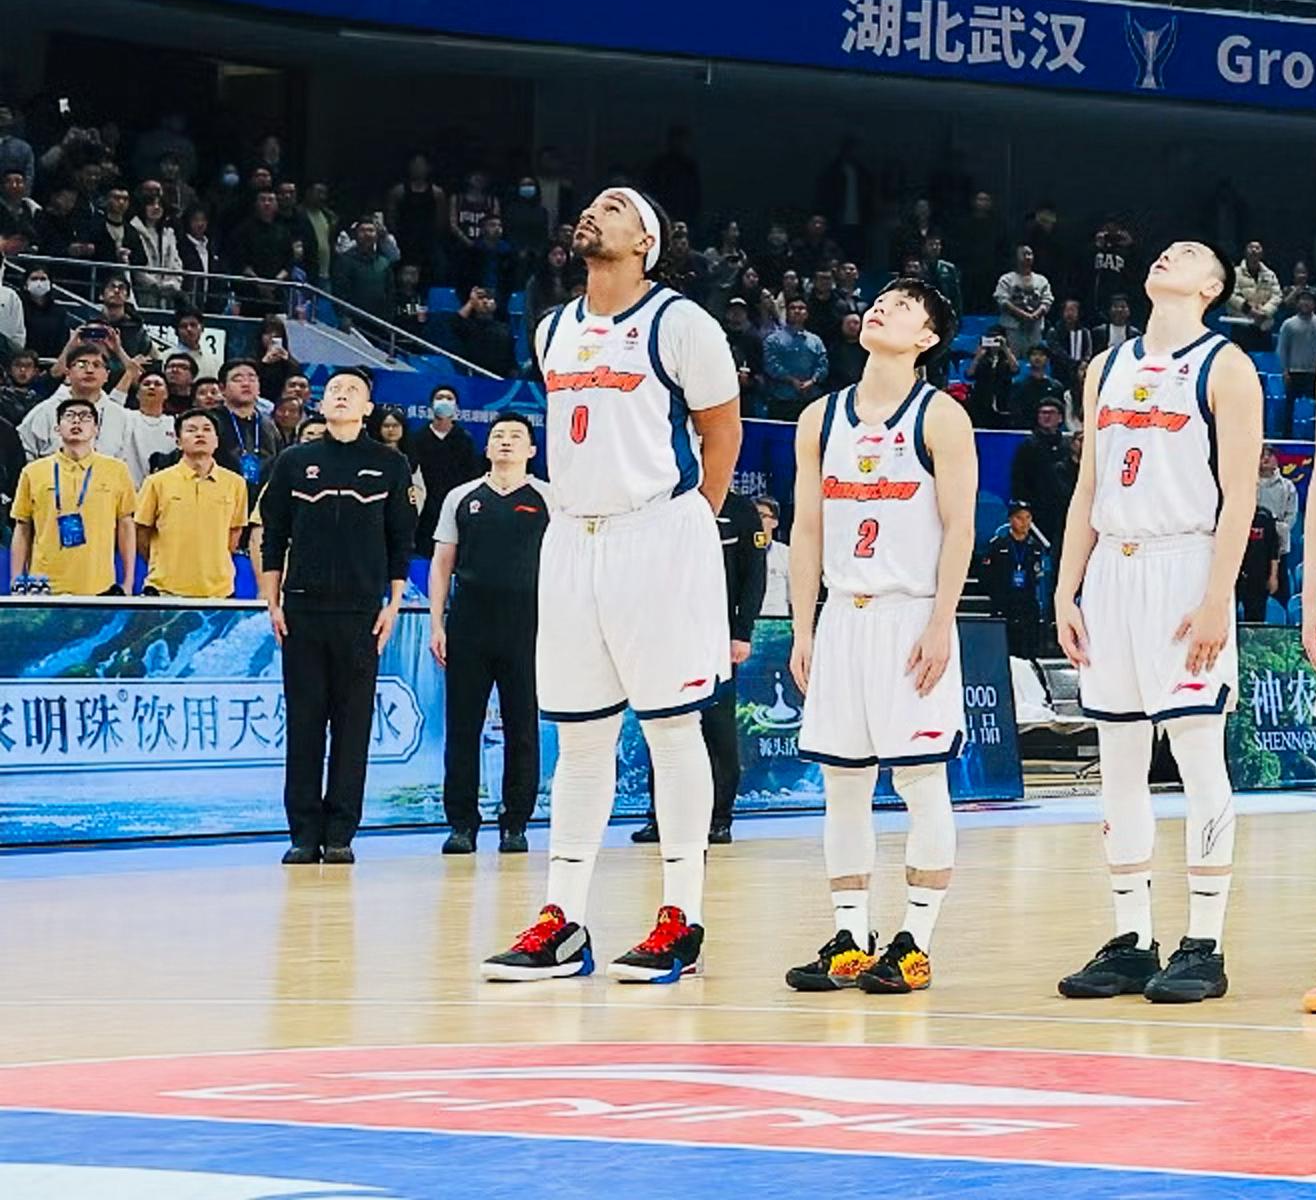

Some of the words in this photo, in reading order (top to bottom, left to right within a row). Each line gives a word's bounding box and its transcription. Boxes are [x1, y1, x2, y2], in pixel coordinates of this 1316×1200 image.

[570, 405, 589, 444] 0
[1121, 447, 1142, 487] 3
[854, 518, 879, 558] 2
[158, 1083, 1080, 1137] LI-NING
